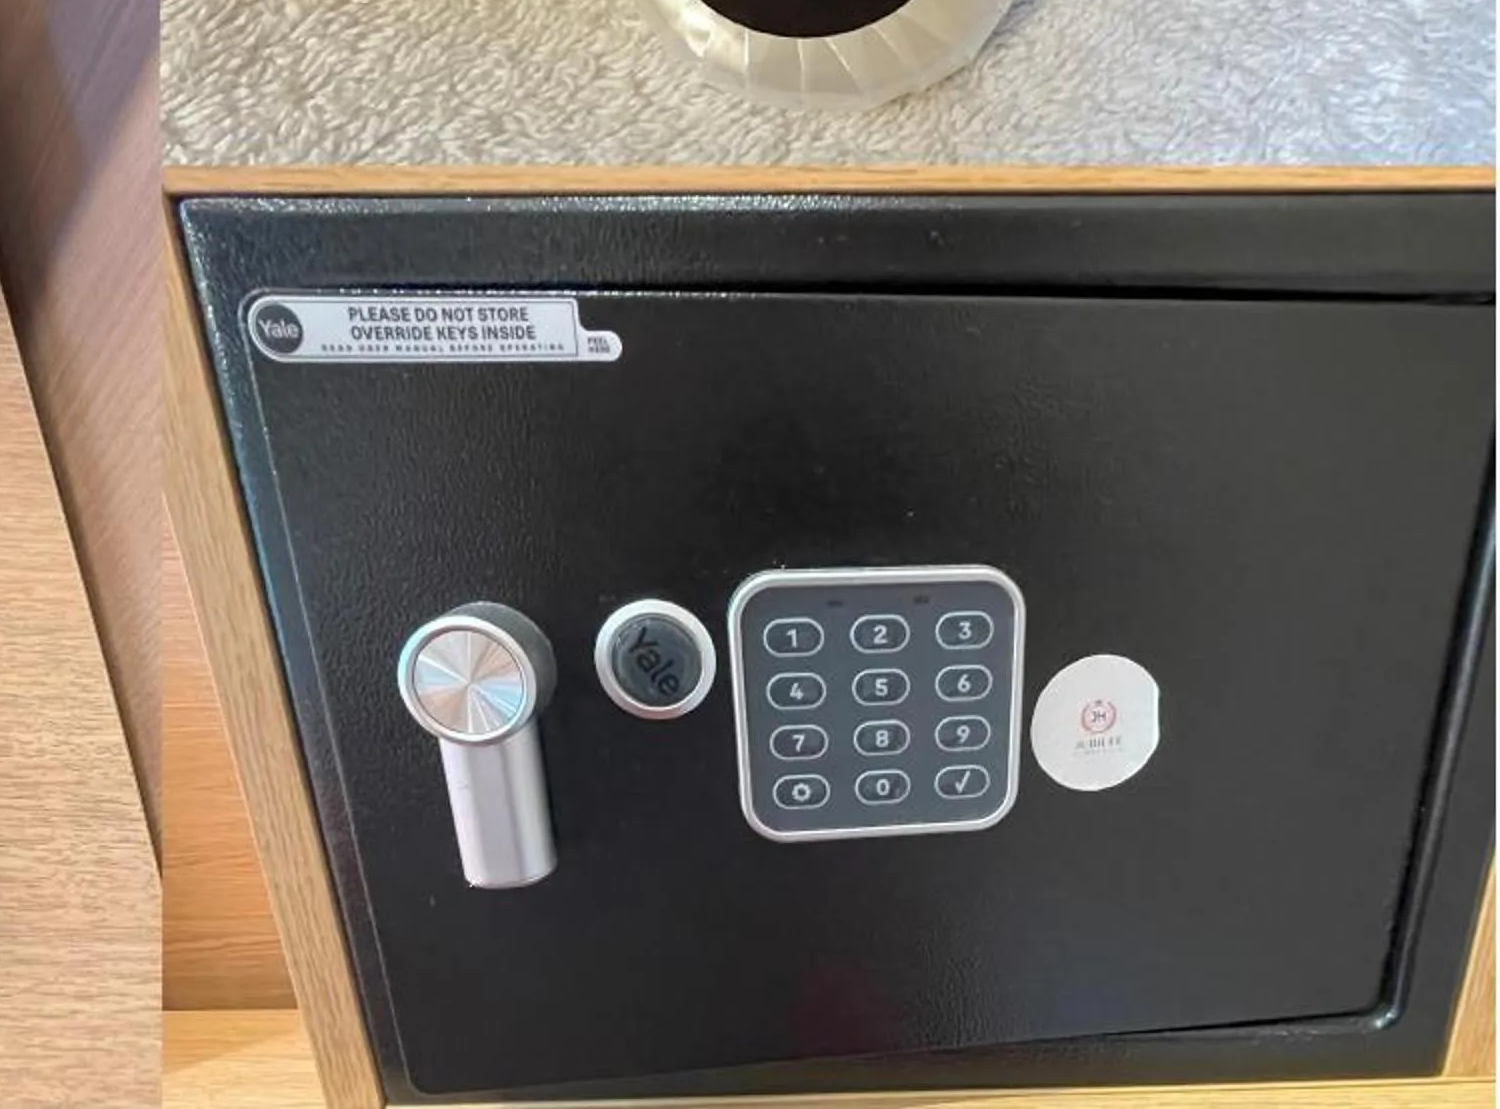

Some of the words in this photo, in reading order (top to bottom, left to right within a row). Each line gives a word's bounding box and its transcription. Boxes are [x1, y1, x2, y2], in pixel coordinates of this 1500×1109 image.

[347, 306, 411, 322] PLEASE
[415, 307, 438, 321] DO
[442, 307, 474, 321] NOT
[477, 307, 529, 322] STORE
[257, 317, 300, 340] Yale
[350, 325, 433, 341] OVERRIDE
[436, 325, 478, 341] KEYS
[482, 325, 537, 340] INSIDE
[786, 628, 798, 648] 1
[873, 624, 888, 644] 2
[958, 622, 973, 640] 3
[627, 626, 680, 697] Yale
[789, 682, 804, 700] 4
[874, 678, 889, 697] 5
[956, 674, 972, 693] 6
[791, 734, 805, 752] 7
[875, 730, 890, 748] 8
[956, 725, 971, 743] 9
[876, 778, 891, 796] 0
